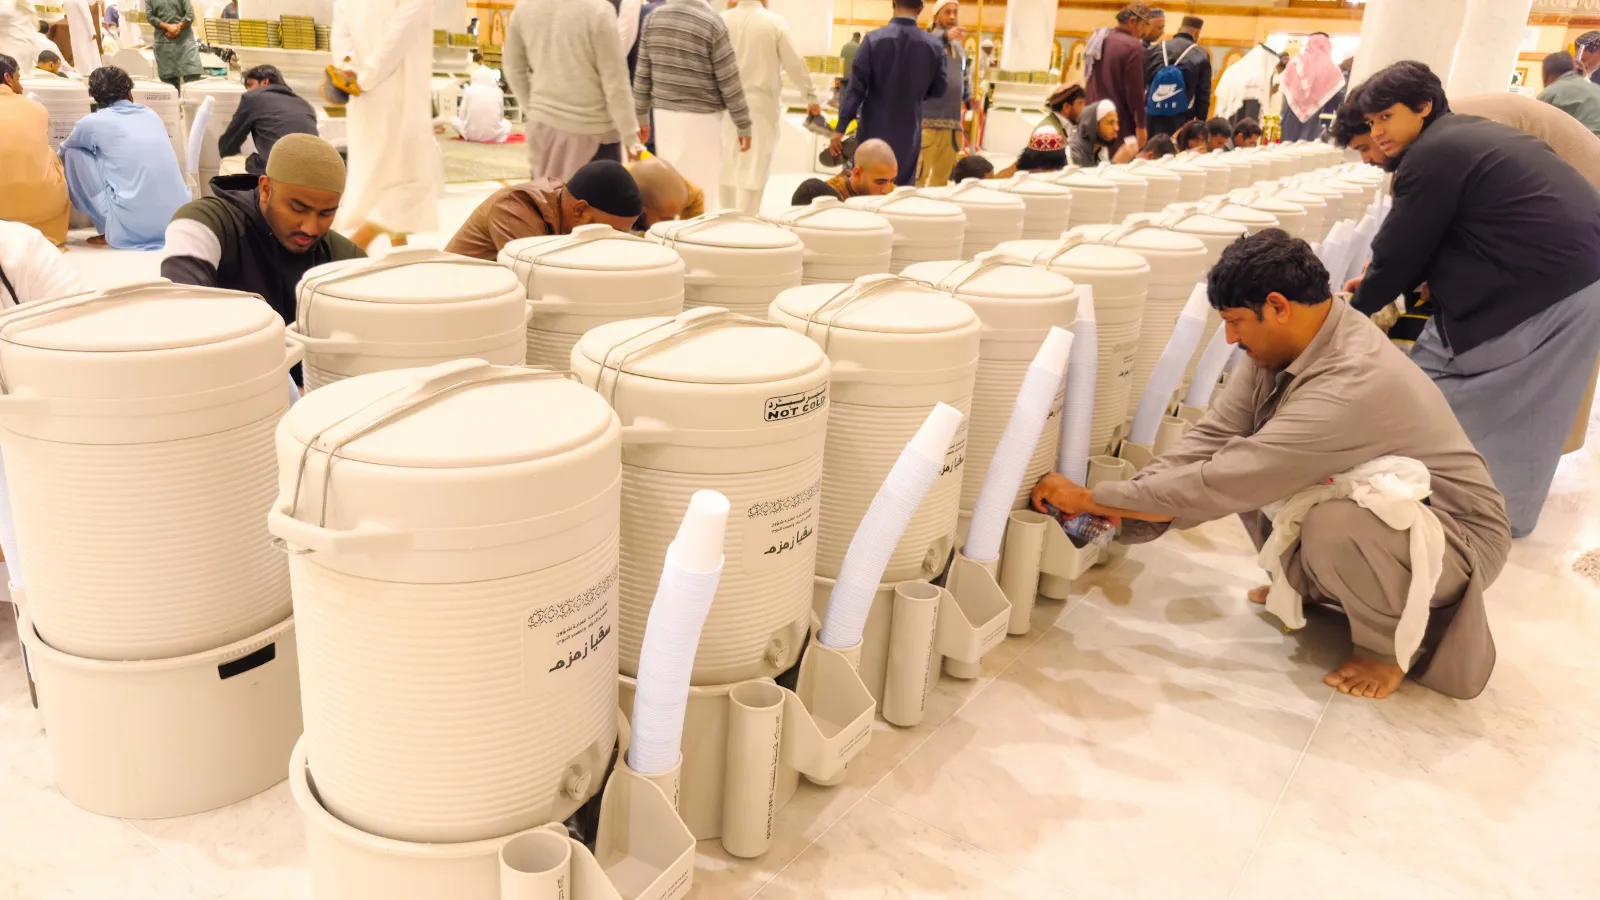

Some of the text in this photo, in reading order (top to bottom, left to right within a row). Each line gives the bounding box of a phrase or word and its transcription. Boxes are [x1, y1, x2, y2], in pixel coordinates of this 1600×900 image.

[767, 396, 826, 420] NOT COLD
[763, 525, 813, 555] سقيا زمزم
[548, 624, 611, 673] سقيا زمزم
